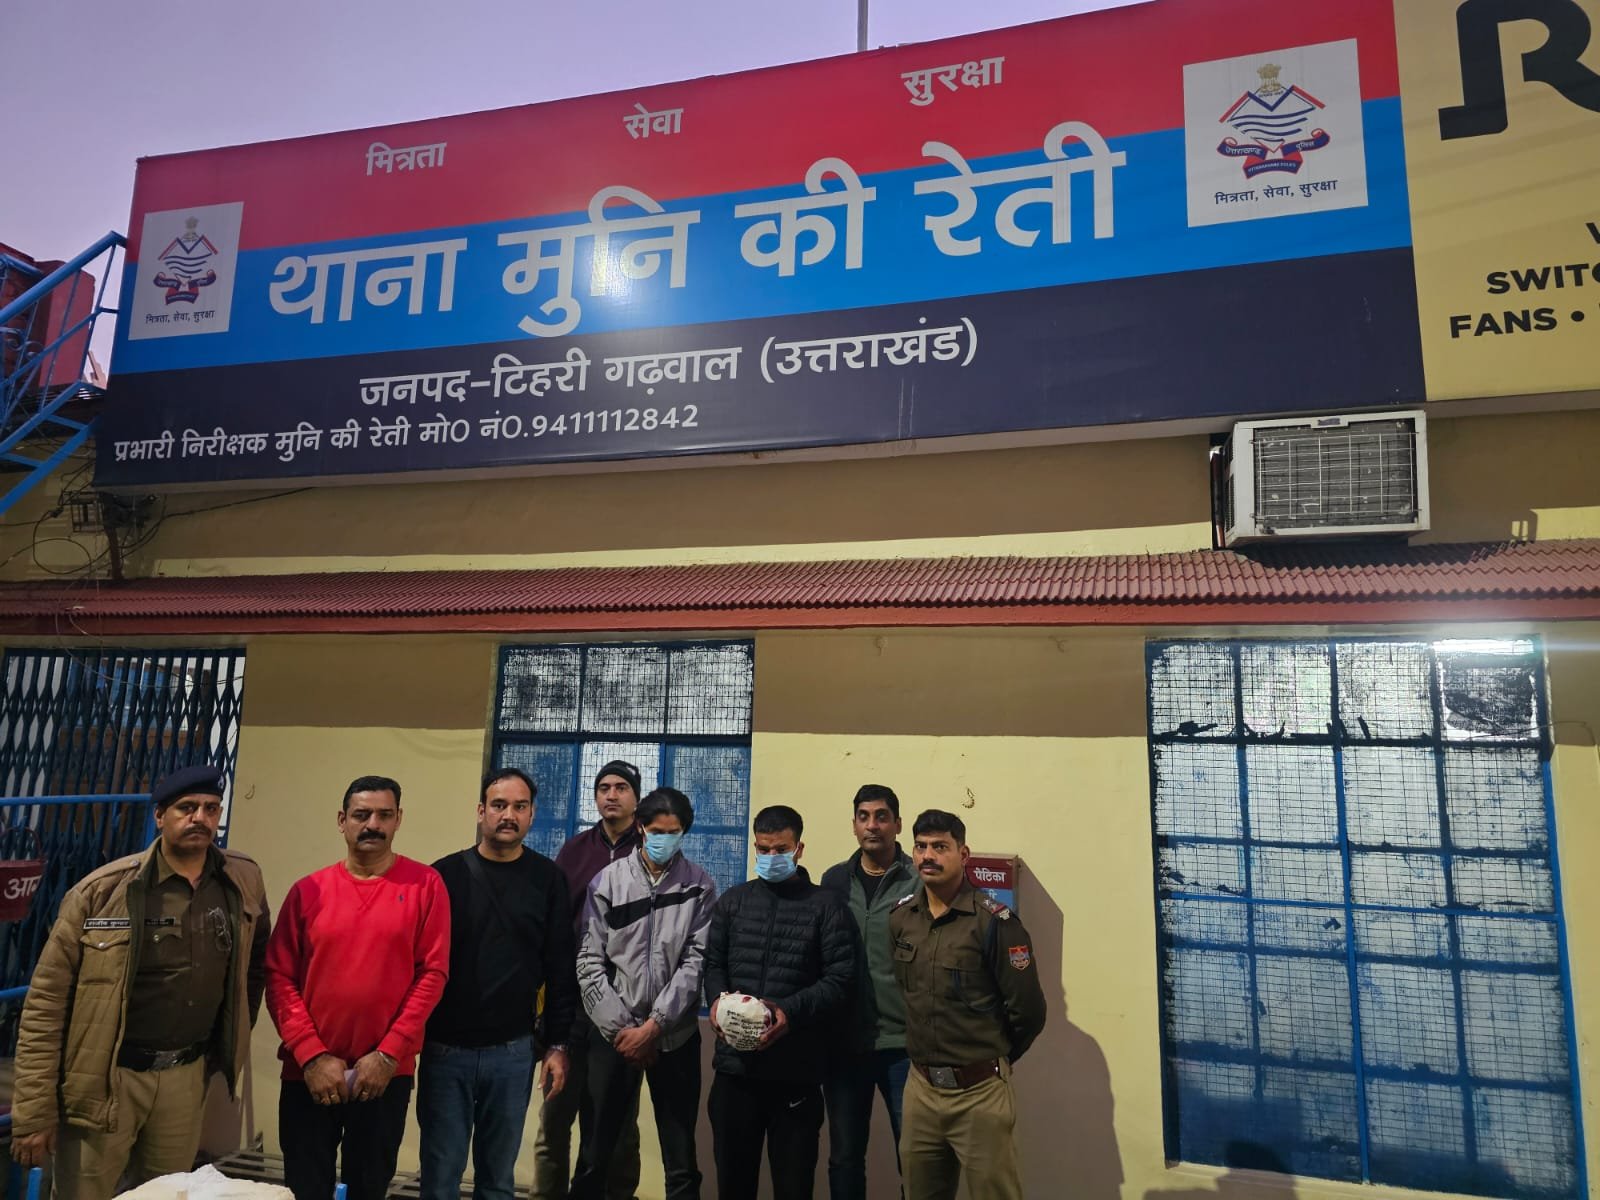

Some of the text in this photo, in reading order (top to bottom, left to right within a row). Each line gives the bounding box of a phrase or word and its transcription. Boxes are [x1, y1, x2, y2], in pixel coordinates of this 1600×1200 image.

[366, 56, 1005, 175] मित्रता सेवा सुरक्षा
[1263, 184, 1294, 198] सेवा,
[1299, 179, 1338, 198] सुरक्षा
[269, 121, 1126, 338] थाना मुनि की रेती
[1450, 307, 1557, 339] FANS
[603, 347, 742, 396] गढ़वाल
[760, 316, 978, 384] (उत्तराखंड)
[114, 430, 174, 462] प्रभारी
[181, 427, 269, 457] निरीक्षक
[274, 421, 323, 462] मुनि
[330, 418, 361, 449] की
[368, 415, 411, 447] रेती
[973, 867, 1006, 883] पेटिका
